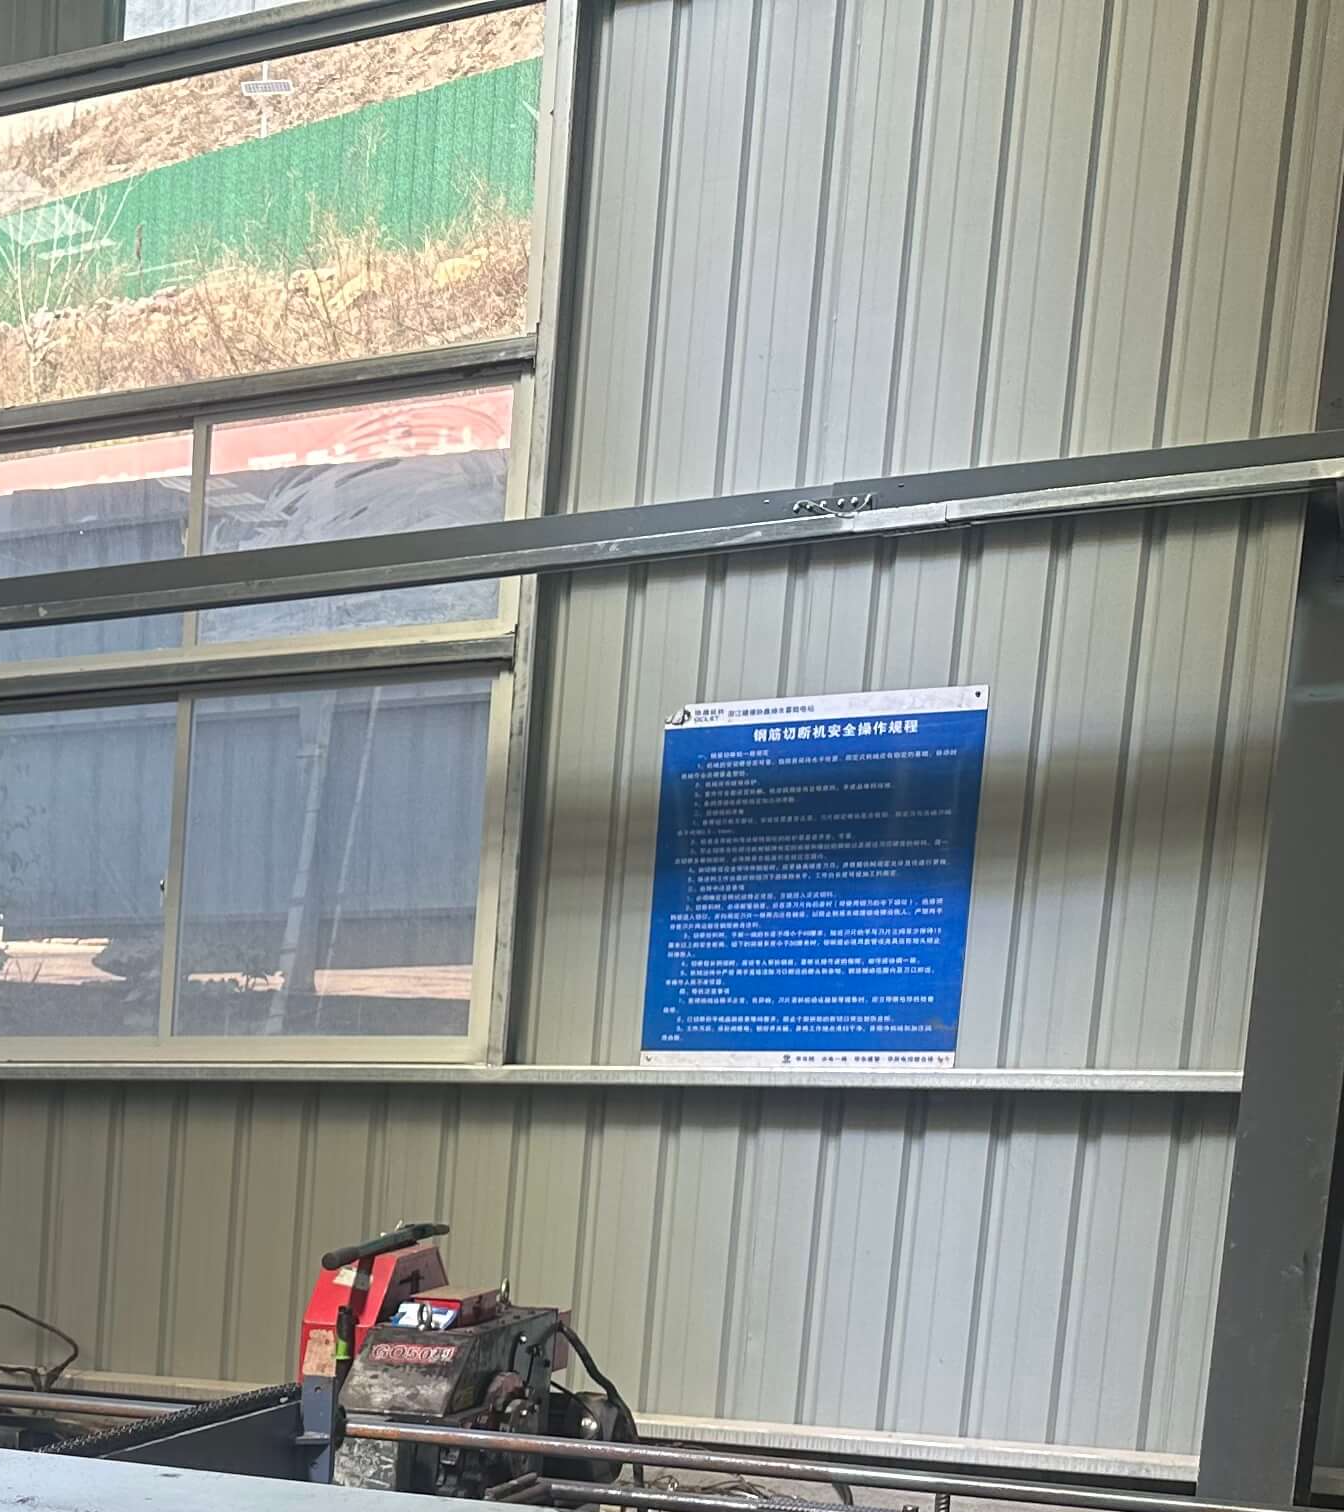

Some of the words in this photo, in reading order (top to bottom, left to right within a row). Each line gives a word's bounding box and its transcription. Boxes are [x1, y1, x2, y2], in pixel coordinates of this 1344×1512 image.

[753, 719, 918, 743] 钢筋切断机安全操作规程
